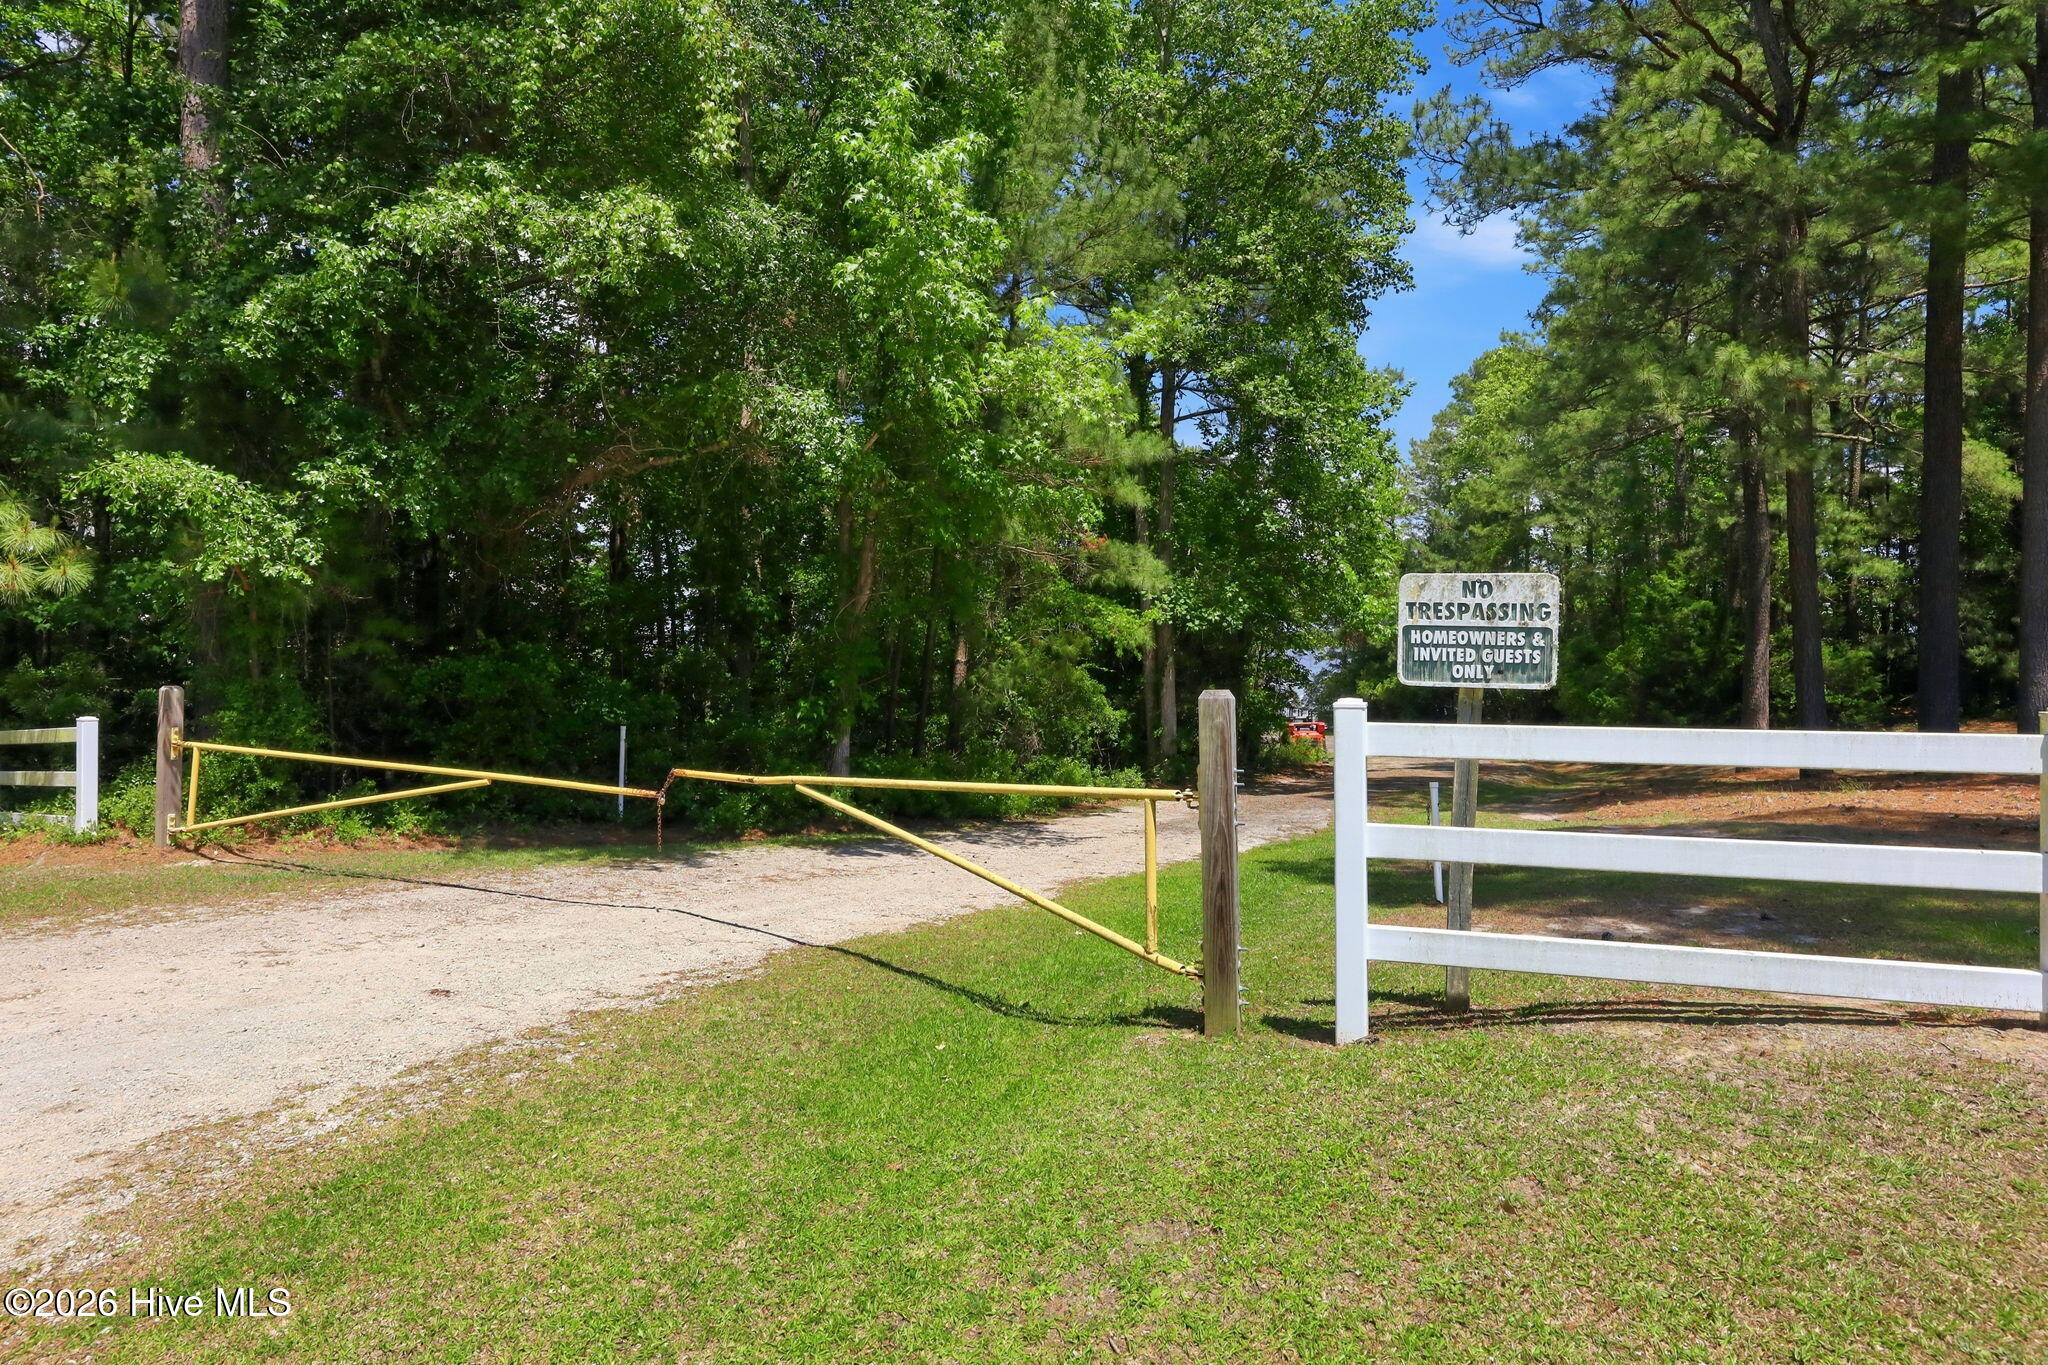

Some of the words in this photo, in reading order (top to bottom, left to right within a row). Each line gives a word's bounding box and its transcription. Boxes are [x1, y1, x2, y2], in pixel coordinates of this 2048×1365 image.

[1462, 580, 1493, 598] NO
[1406, 602, 1551, 621] TRESPASSING
[1410, 630, 1526, 646] HOMEOWNERS
[1532, 632, 1545, 647] &
[1413, 647, 1476, 663] INVITED
[1482, 650, 1541, 664] GUESTS
[1452, 665, 1494, 679] ONLY
